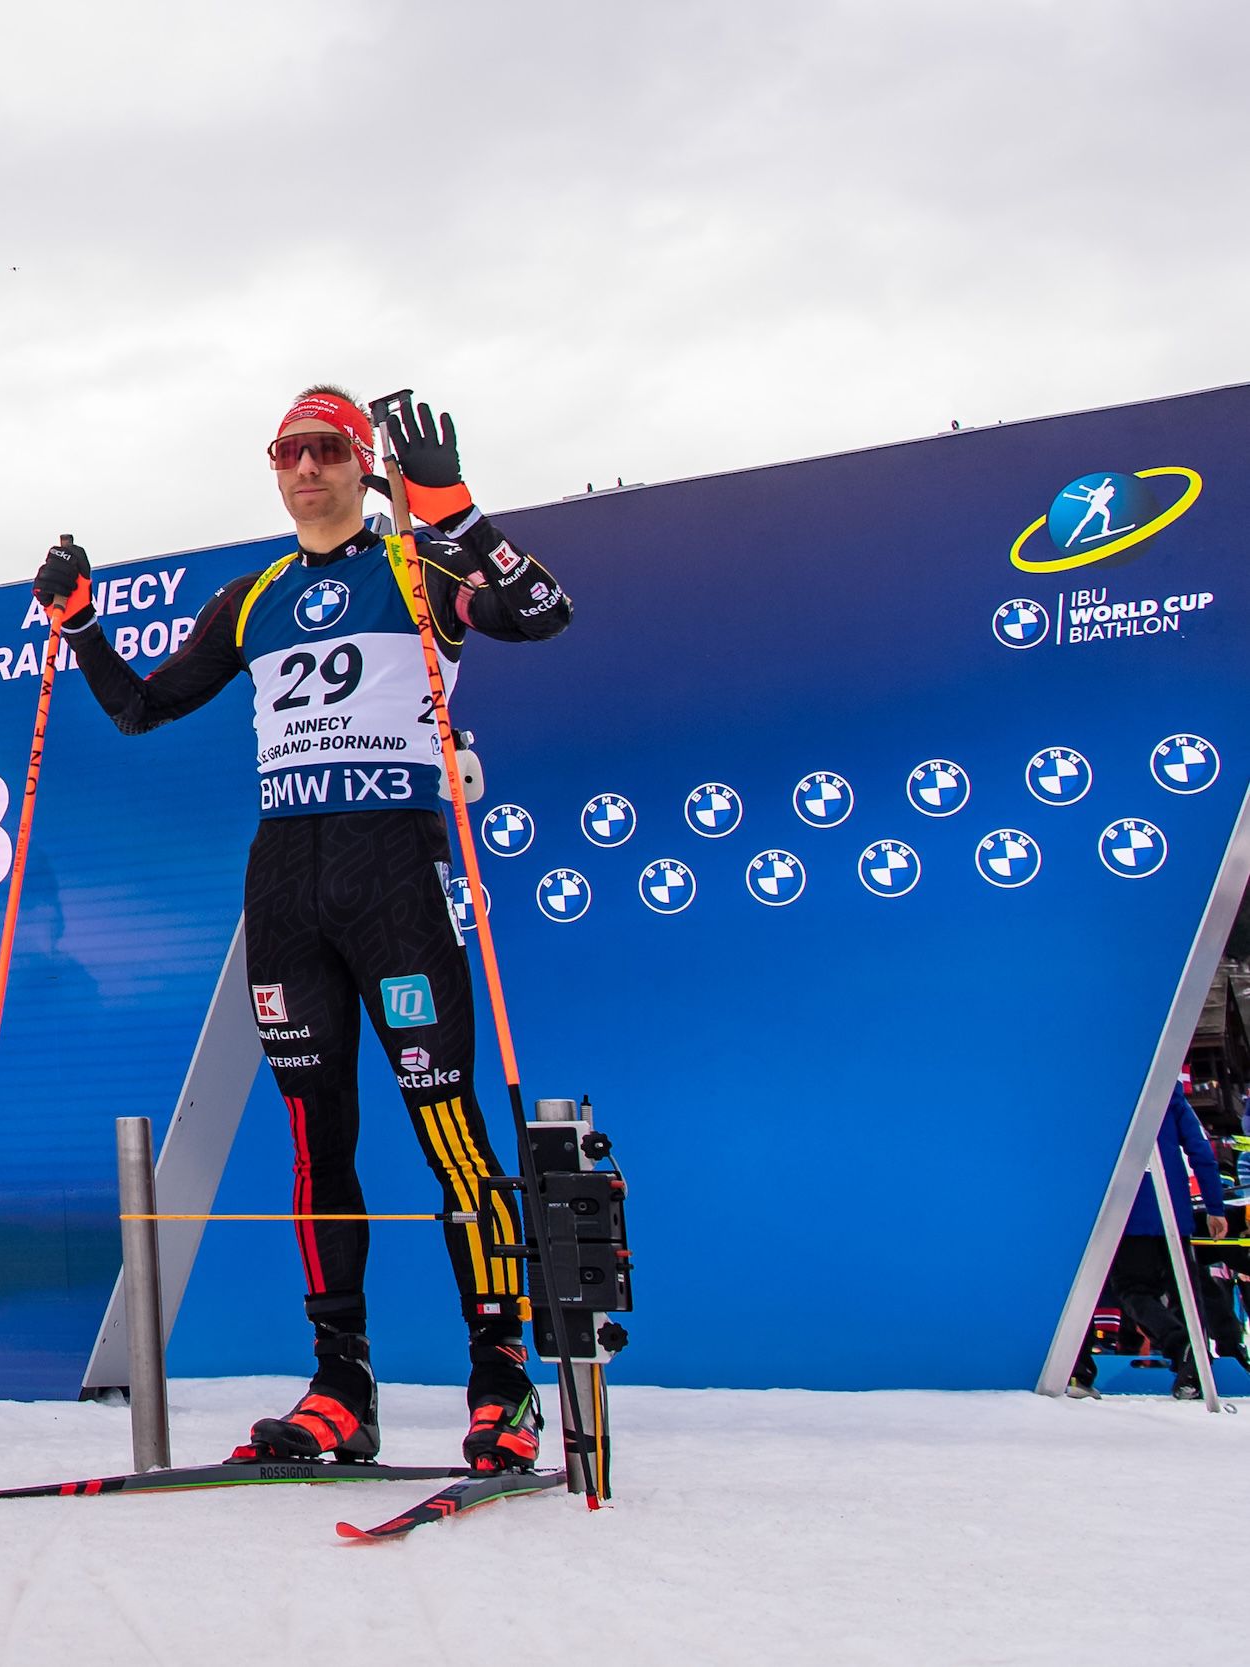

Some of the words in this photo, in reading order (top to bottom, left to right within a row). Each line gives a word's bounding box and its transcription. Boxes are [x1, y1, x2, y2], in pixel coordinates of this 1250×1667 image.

[21, 567, 187, 630] ANECY
[1071, 587, 1107, 607] IBU
[998, 601, 1040, 618] BMW
[1069, 599, 1159, 625] WORLD
[1163, 592, 1214, 613] CUP
[1069, 614, 1179, 644] BIATHLON
[272, 642, 363, 712] 29
[284, 716, 353, 737] ANNECY
[267, 735, 407, 760] GRAND-BORNAND
[1158, 737, 1209, 757] BMW
[1032, 750, 1081, 768] BMW
[913, 762, 959, 781] BMW
[261, 769, 331, 811] BMW
[344, 768, 413, 802] iX3
[800, 774, 844, 792] BMW
[692, 785, 732, 802] BMW
[588, 797, 627, 813] BMW
[488, 807, 526, 824] BMW
[1106, 821, 1156, 840] BMW
[864, 842, 910, 860] BMW
[982, 832, 1030, 851] BMW
[645, 861, 686, 878] BMW
[753, 852, 795, 870] BMW
[543, 871, 583, 888] BMW
[387, 983, 428, 1021] TQ
[257, 1025, 311, 1040] aufland
[397, 1068, 461, 1089] ectake
